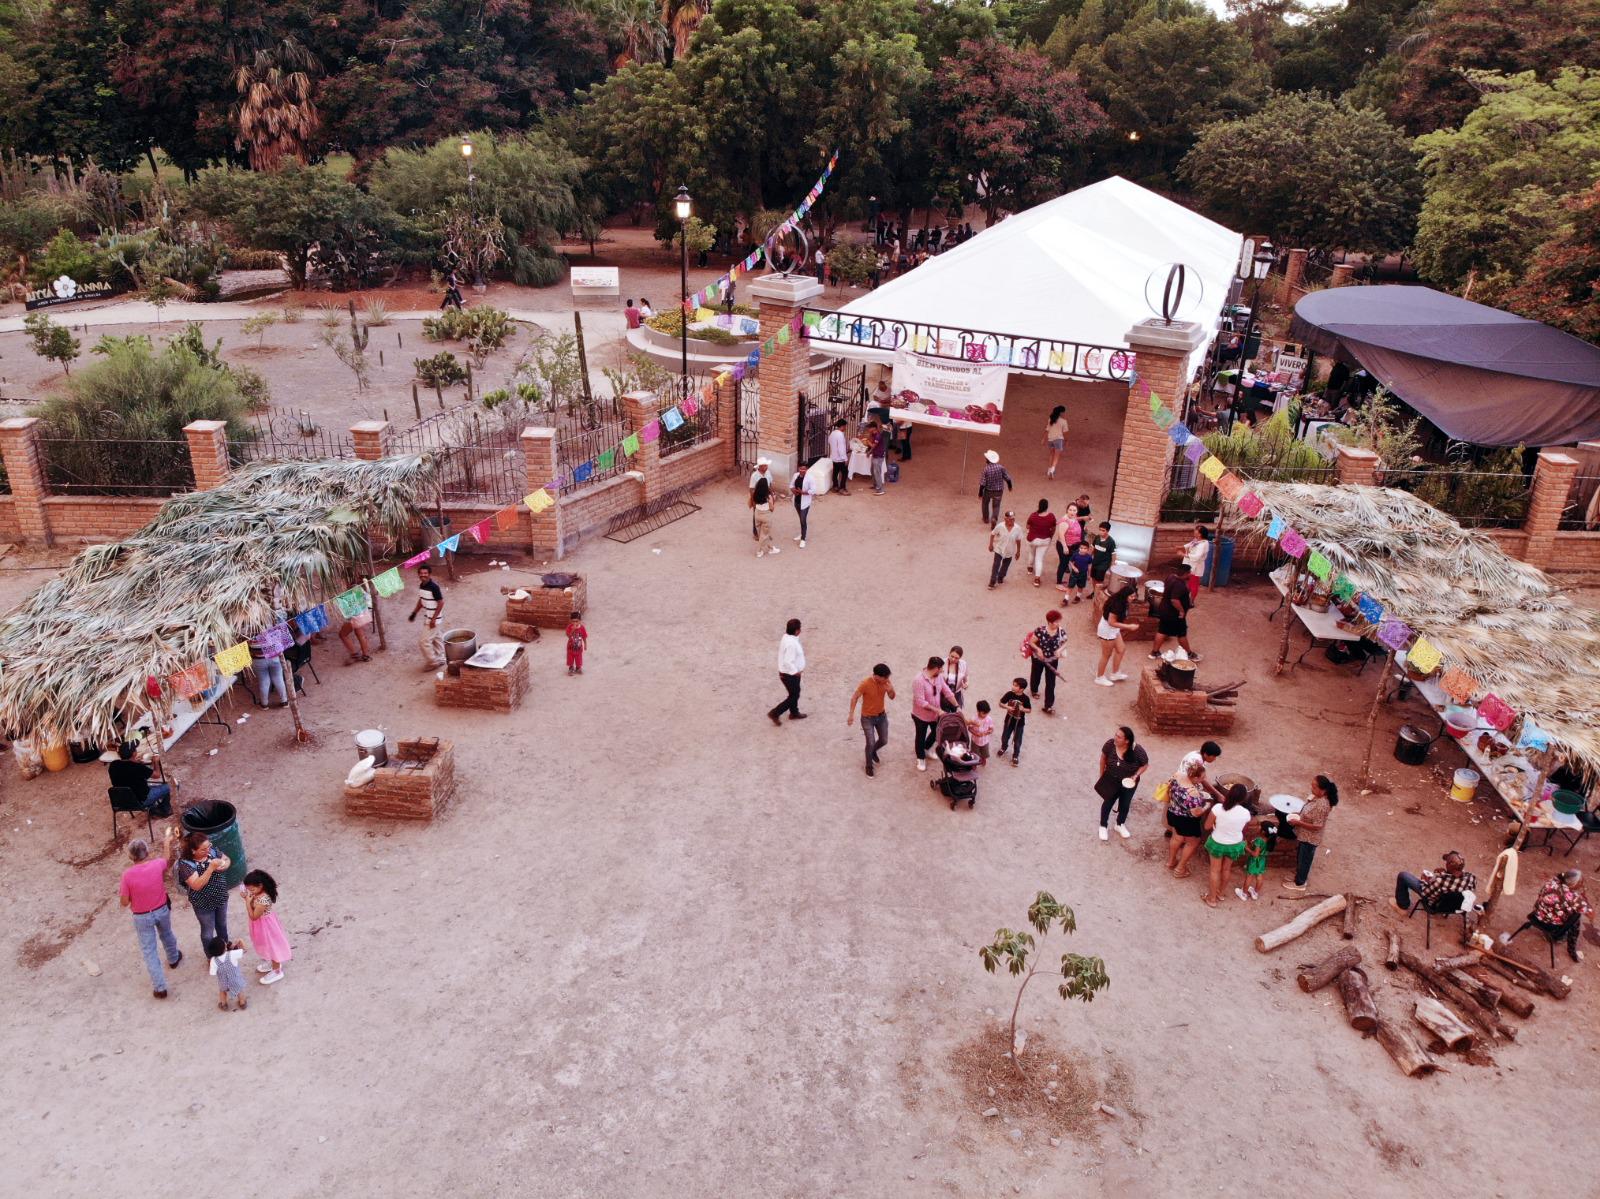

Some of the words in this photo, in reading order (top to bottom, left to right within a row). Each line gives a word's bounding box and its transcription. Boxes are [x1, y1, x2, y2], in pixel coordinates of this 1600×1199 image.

[916, 359, 970, 374] BIENVENIDOS
[972, 367, 983, 376] AL
[1280, 358, 1307, 370] VIVERO
